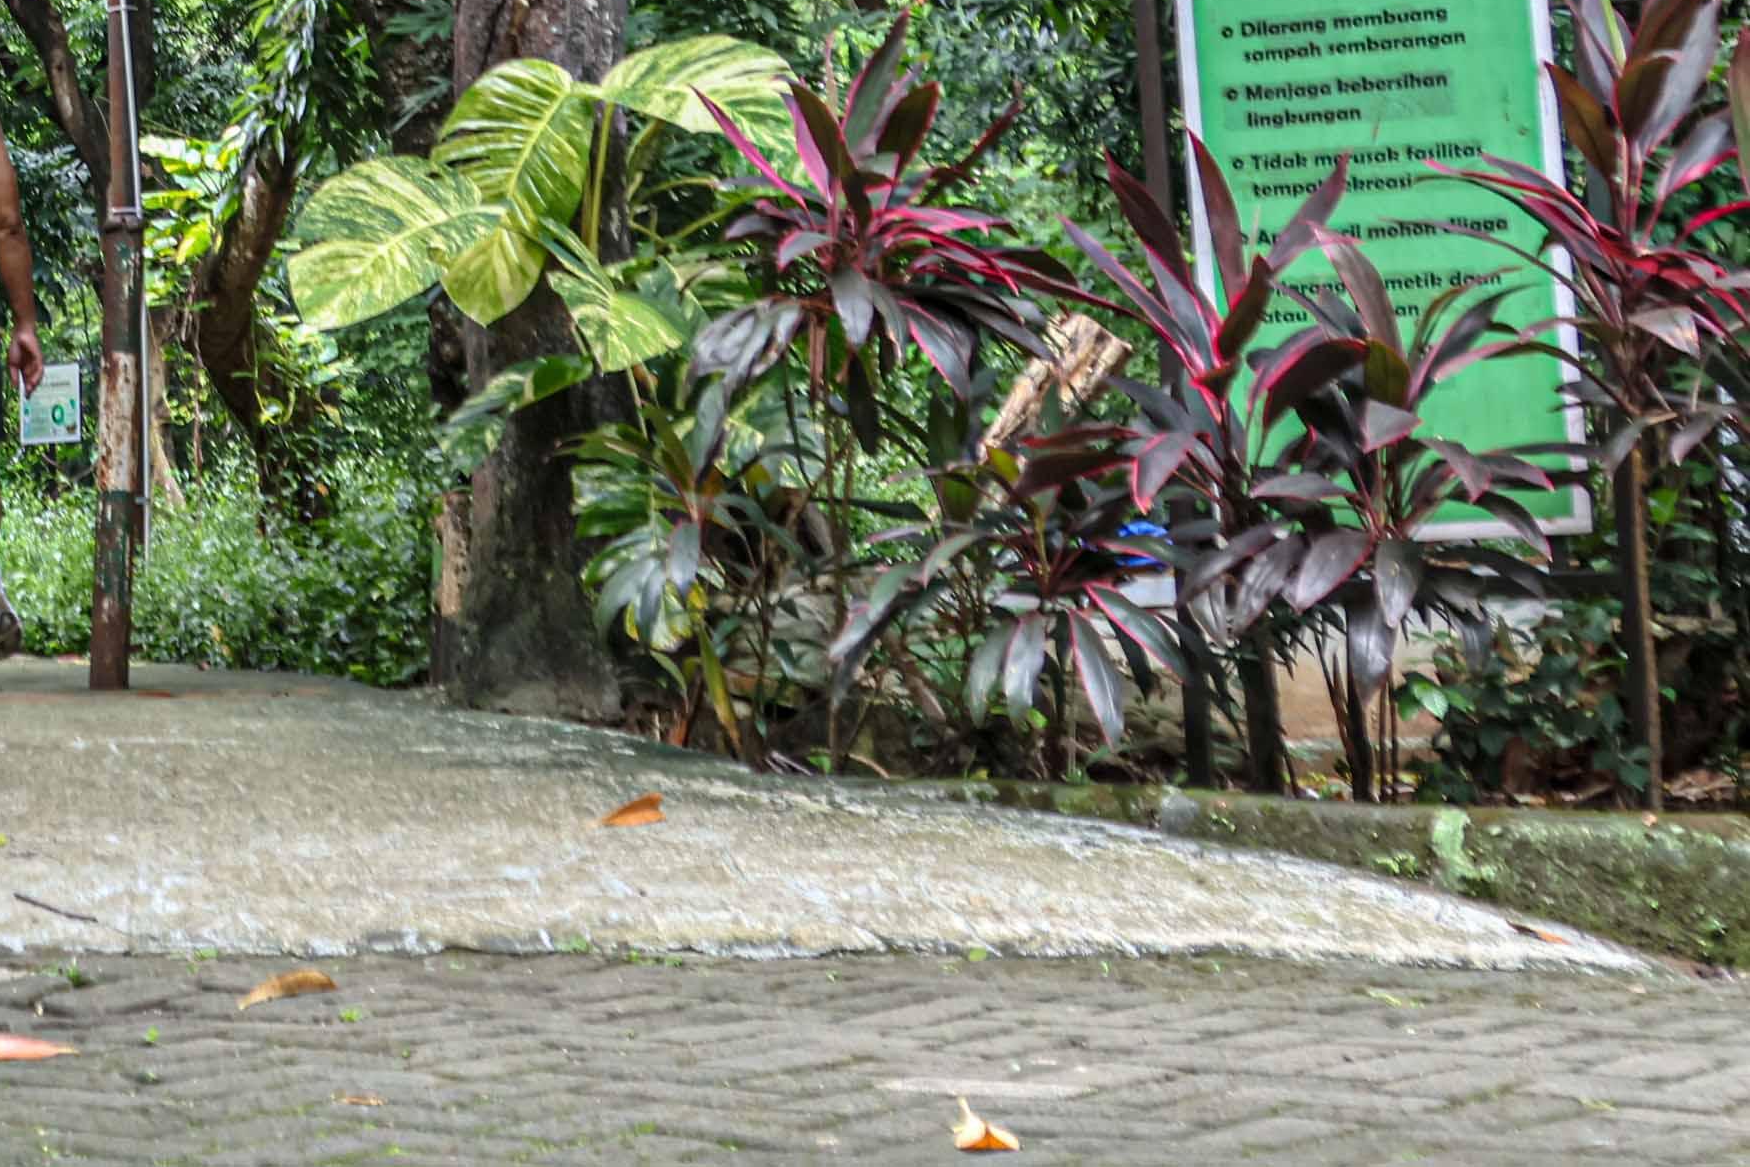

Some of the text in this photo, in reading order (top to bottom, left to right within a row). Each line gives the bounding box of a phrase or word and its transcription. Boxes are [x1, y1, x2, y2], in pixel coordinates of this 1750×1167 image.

[1240, 7, 1448, 39] Dilarang membuang
[1243, 31, 1466, 63] sampah sembarangan
[1244, 71, 1448, 103] Menjaga kebersihan
[1246, 107, 1362, 129] lingkungan
[1250, 152, 1307, 171] Tidak
[1406, 140, 1482, 161] fasilitas
[1366, 220, 1436, 240] mohon
